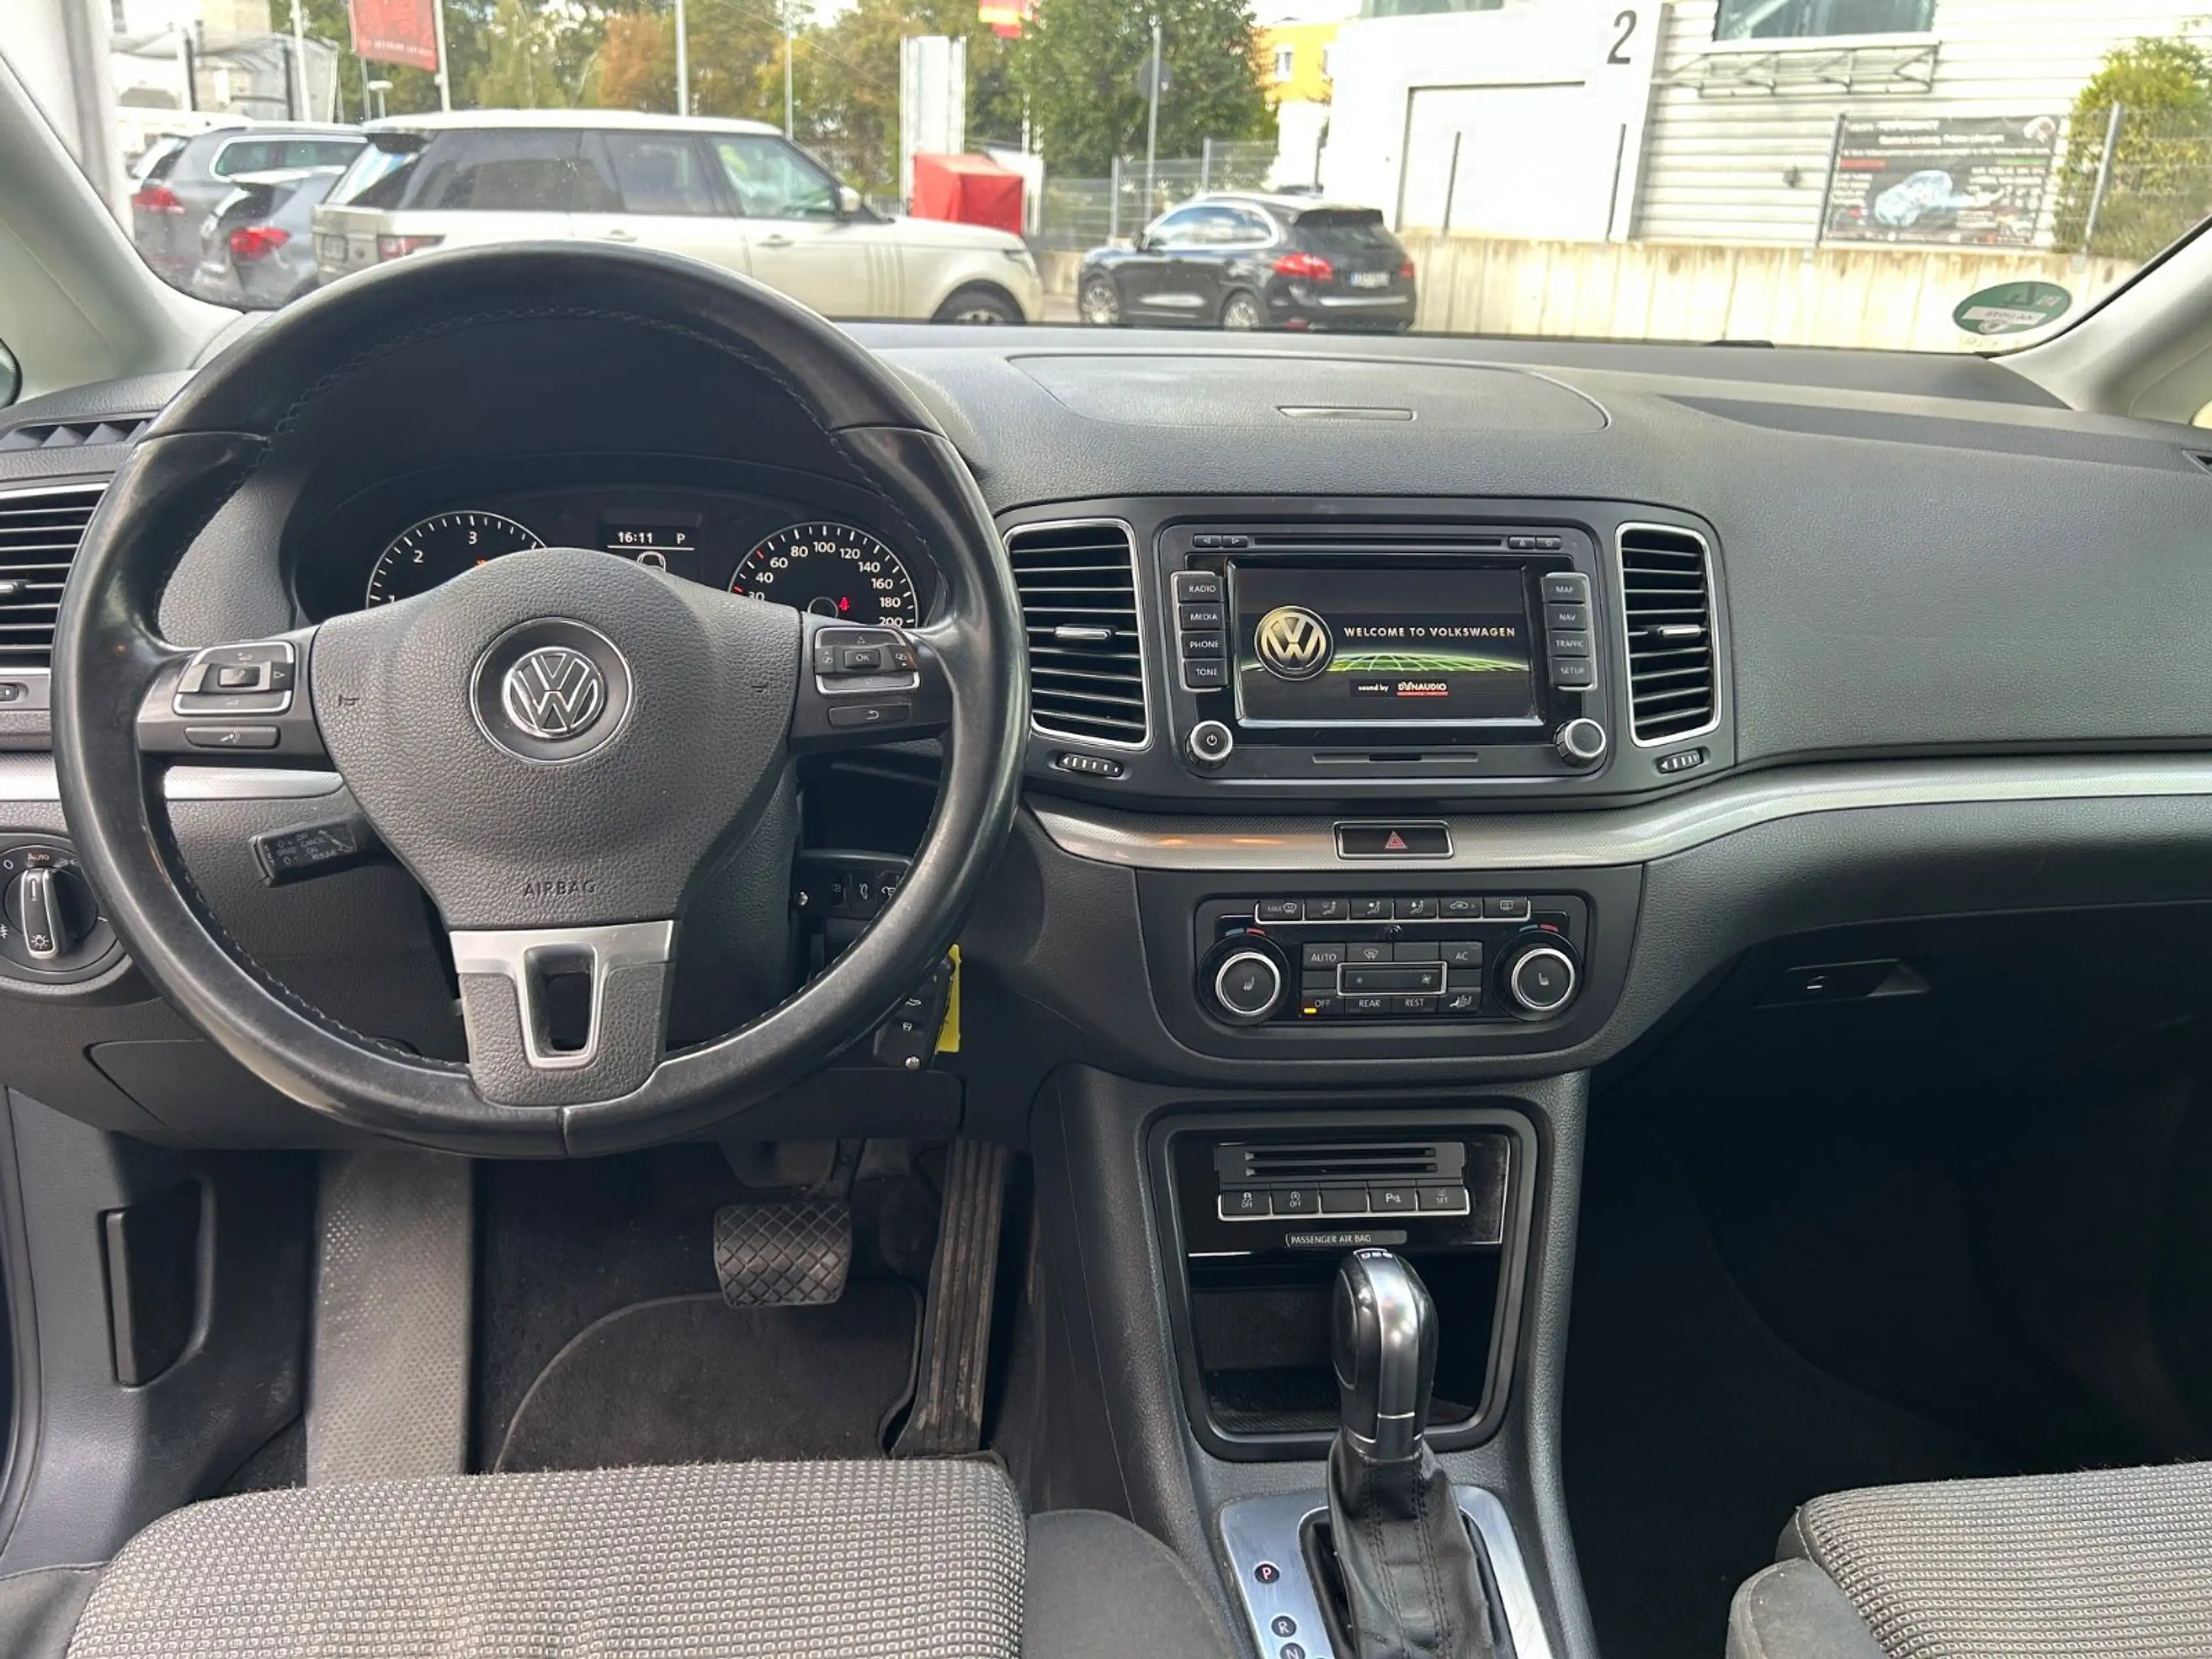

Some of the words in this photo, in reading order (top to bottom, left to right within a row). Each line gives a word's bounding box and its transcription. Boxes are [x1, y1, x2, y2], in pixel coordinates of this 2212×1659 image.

[1607, 10, 1637, 65] 2
[468, 531, 477, 544] 3
[618, 531, 652, 544] 16:11
[676, 532, 685, 544] P
[790, 546, 808, 557] 80
[813, 542, 836, 553] 100
[413, 550, 423, 563] 2
[839, 549, 860, 559] 120
[770, 558, 789, 568] 60
[858, 562, 880, 573] 140
[755, 573, 774, 583] 40
[872, 578, 893, 589] 160
[879, 597, 901, 608] 180
[879, 617, 903, 627] 200
[1344, 627, 1404, 637] WELCOME
[1409, 627, 1425, 637] TO
[1429, 627, 1515, 638] VOLKSWAGEN
[1190, 640, 1219, 648] PHONE
[855, 654, 870, 662] OK
[1560, 666, 1584, 675] SETUP
[1381, 684, 1389, 693] by
[523, 880, 597, 896] AIRBAG
[1310, 953, 1336, 962] AUTO
[1455, 952, 1468, 960] AC
[1405, 998, 1425, 1006] REST
[1291, 1235, 1336, 1244] PASSENGER
[1339, 1234, 1353, 1243] AIR
[1355, 1234, 1371, 1243] BAG
[1262, 1567, 1271, 1580] P
[1278, 1621, 1290, 1634] R
[1285, 1648, 1300, 1659] N
